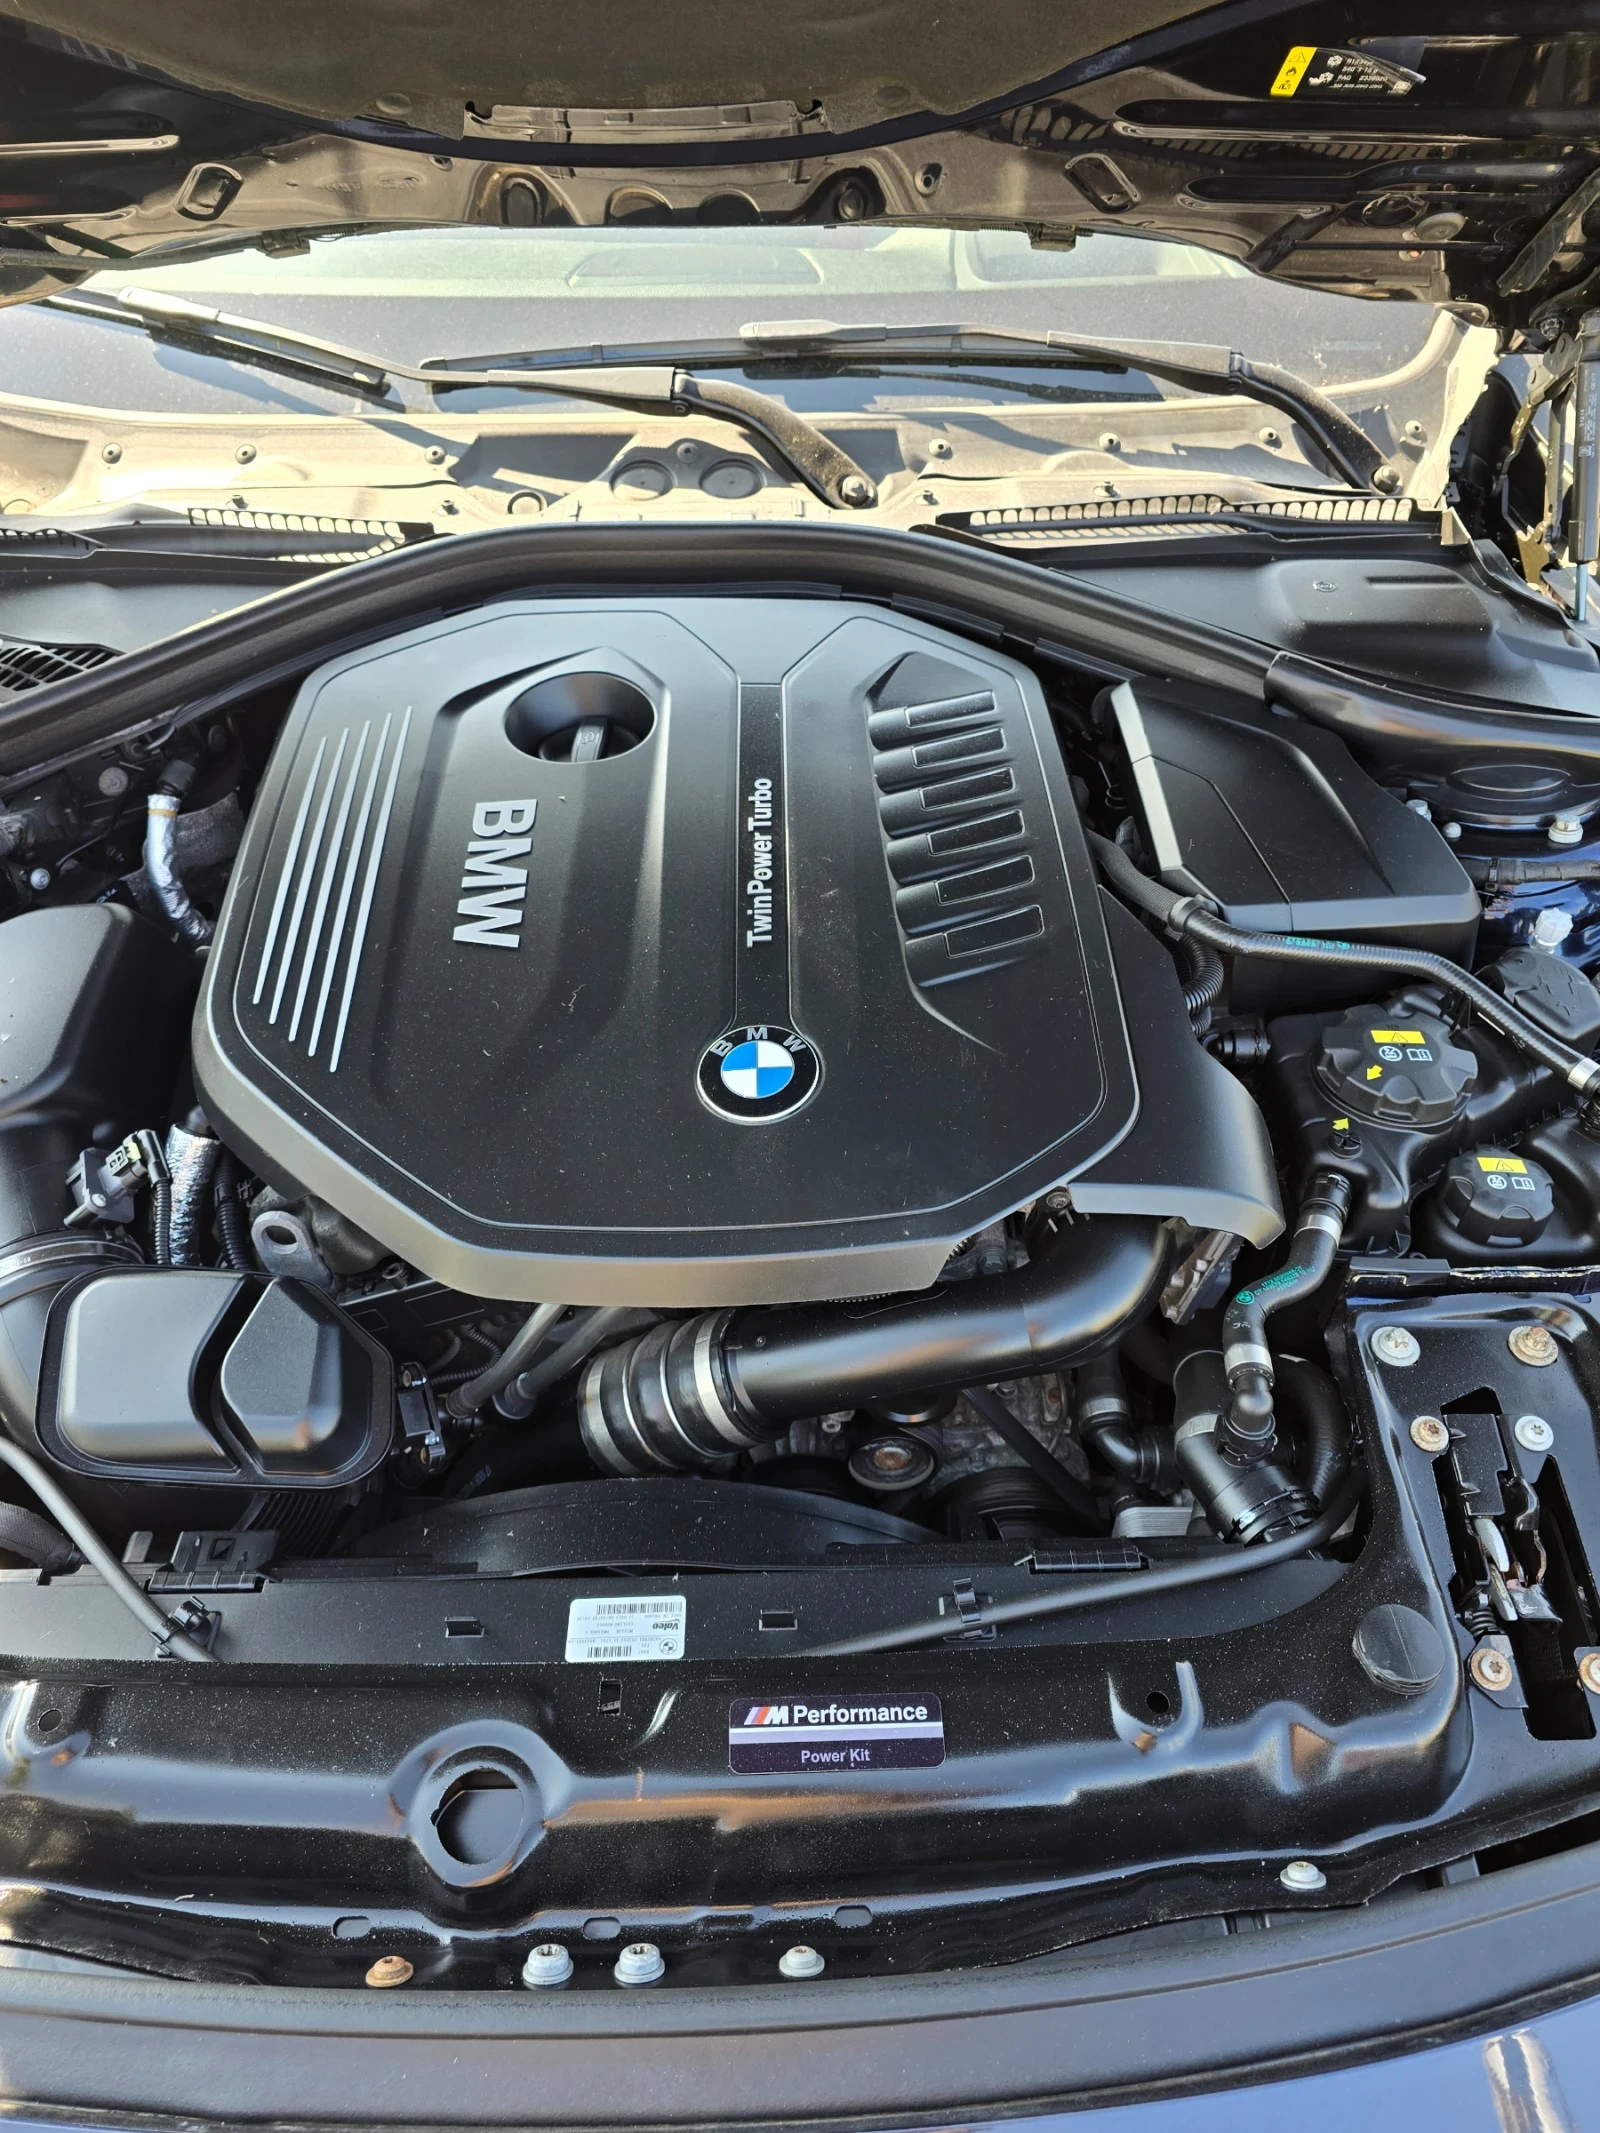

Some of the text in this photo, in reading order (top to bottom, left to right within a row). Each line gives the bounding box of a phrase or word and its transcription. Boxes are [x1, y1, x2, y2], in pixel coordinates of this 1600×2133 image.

[453, 799, 538, 948] BMW
[747, 778, 773, 948] TwinPower Turbo
[710, 1026, 807, 1058] BMW
[652, 1622, 679, 1631] Valeo
[793, 1704, 928, 1724] Performance
[801, 1748, 871, 1764] Power Kit
